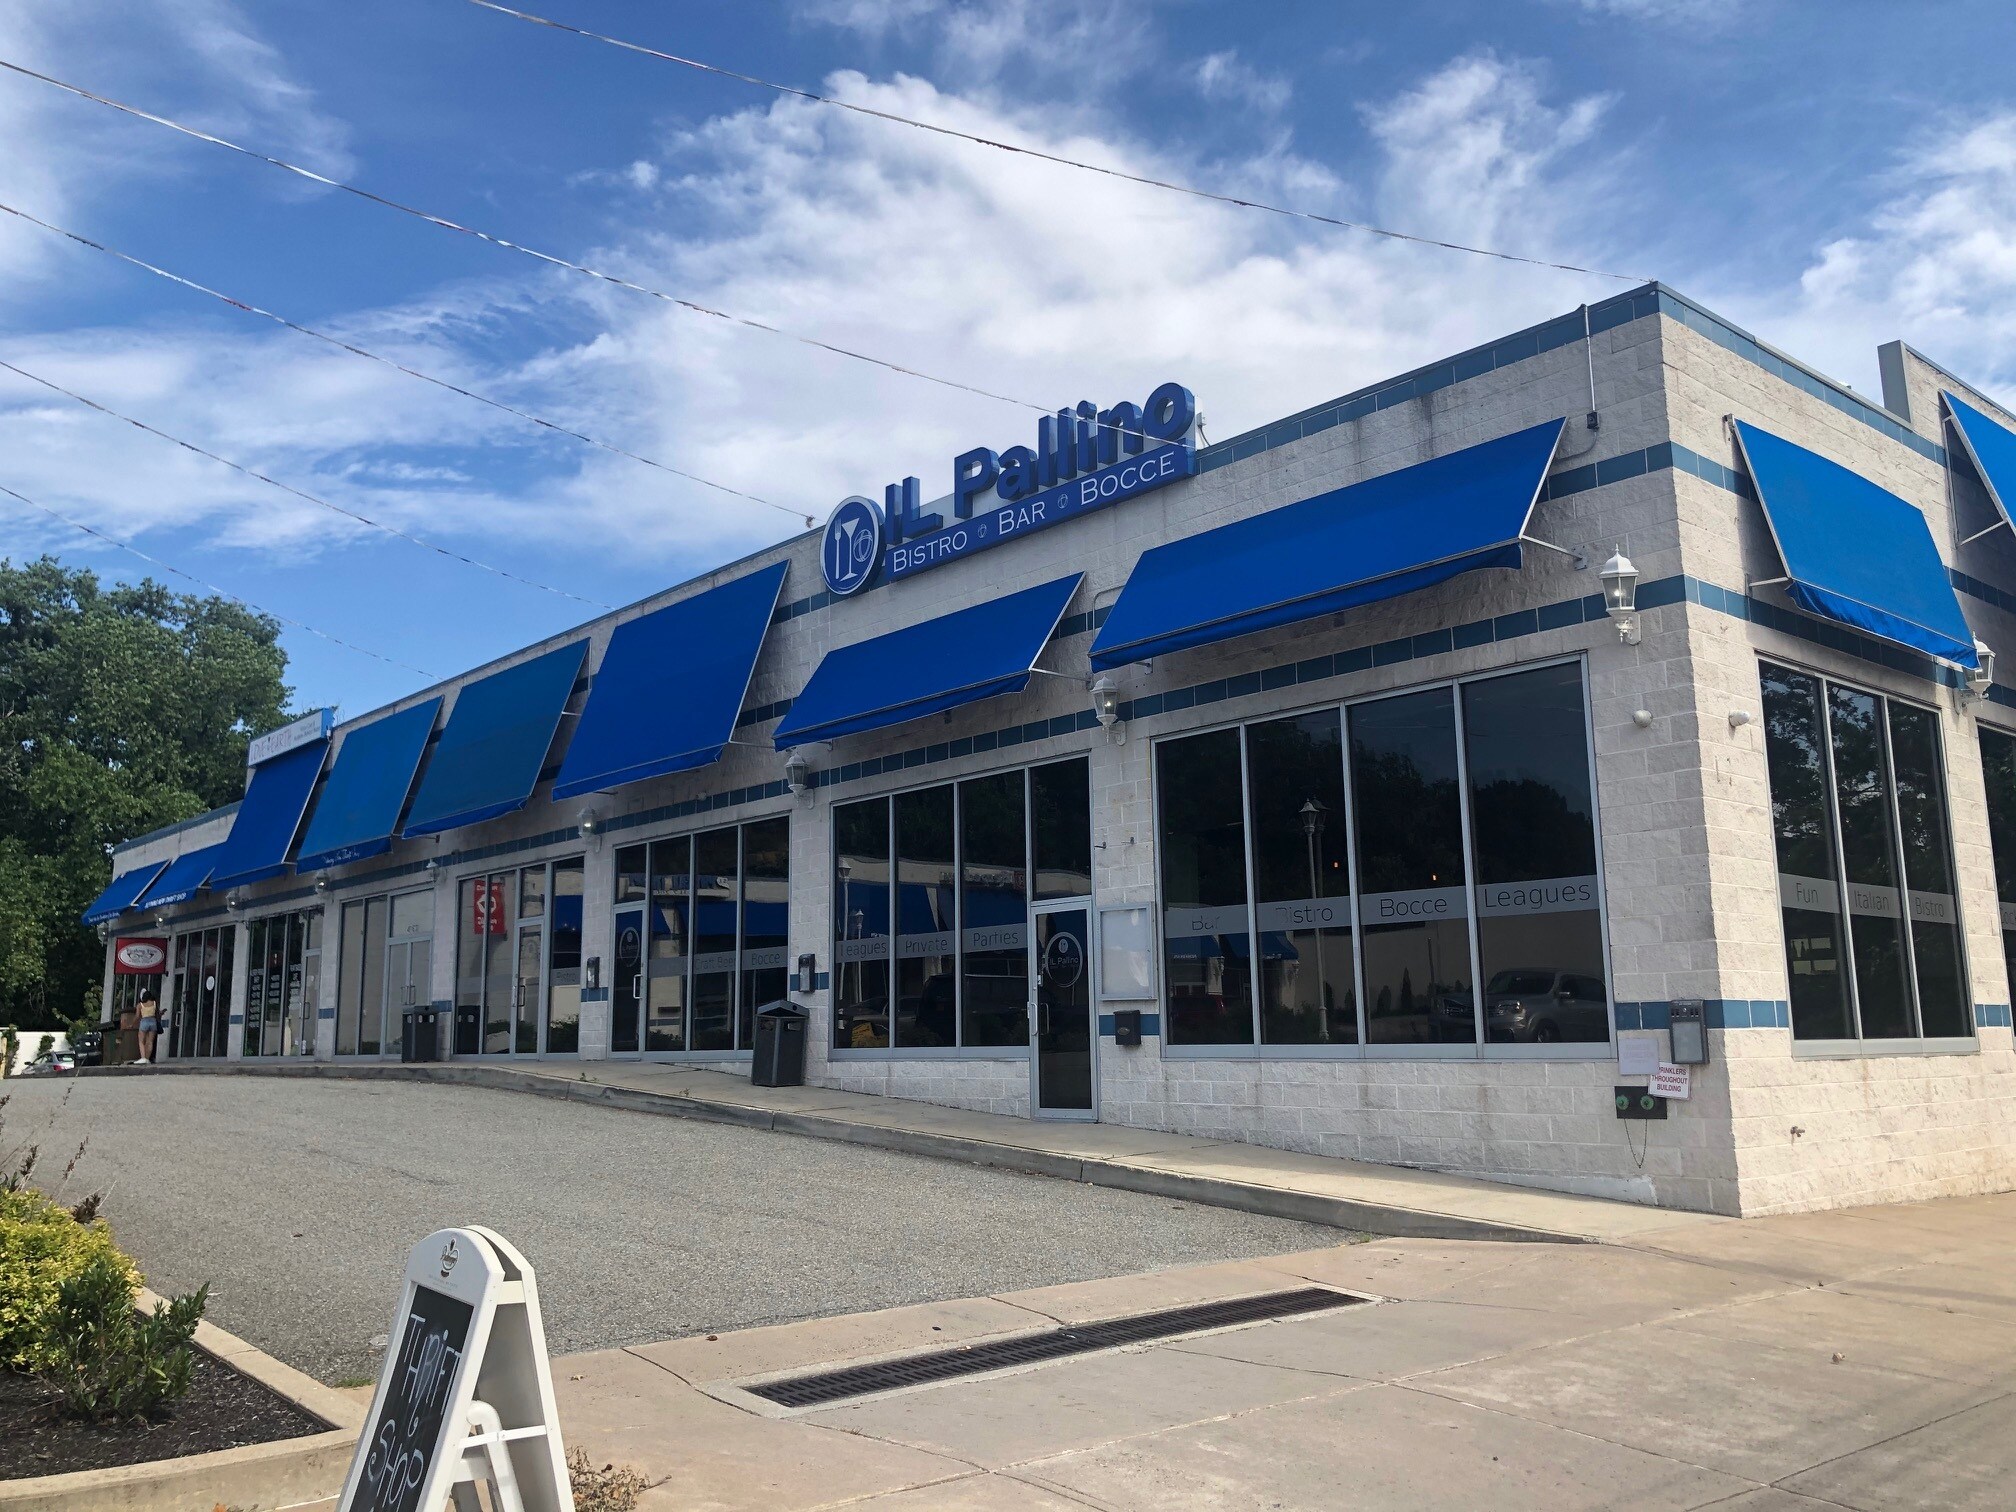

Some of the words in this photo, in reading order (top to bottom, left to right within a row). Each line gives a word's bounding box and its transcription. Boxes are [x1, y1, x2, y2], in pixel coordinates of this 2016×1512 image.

[885, 476, 943, 546] IL
[954, 382, 1195, 519] Pallino
[893, 531, 968, 573] BISTRO
[999, 502, 1046, 536] BAR
[1081, 451, 1175, 506] BOCCE
[1380, 898, 1448, 918] Bocce
[1484, 883, 1592, 910] Leagues
[1795, 882, 1819, 904] Fun
[1853, 889, 1890, 912] Italian
[1915, 897, 1945, 918] Bistro
[840, 940, 887, 959] Leagues
[905, 938, 948, 954] Private
[973, 931, 1019, 948] Parties
[751, 953, 781, 966] Bocce
[1651, 1074, 1688, 1085] THROUGHOUT
[1658, 1066, 1687, 1076] RINKLERS
[1656, 1083, 1682, 1093] BUILDING
